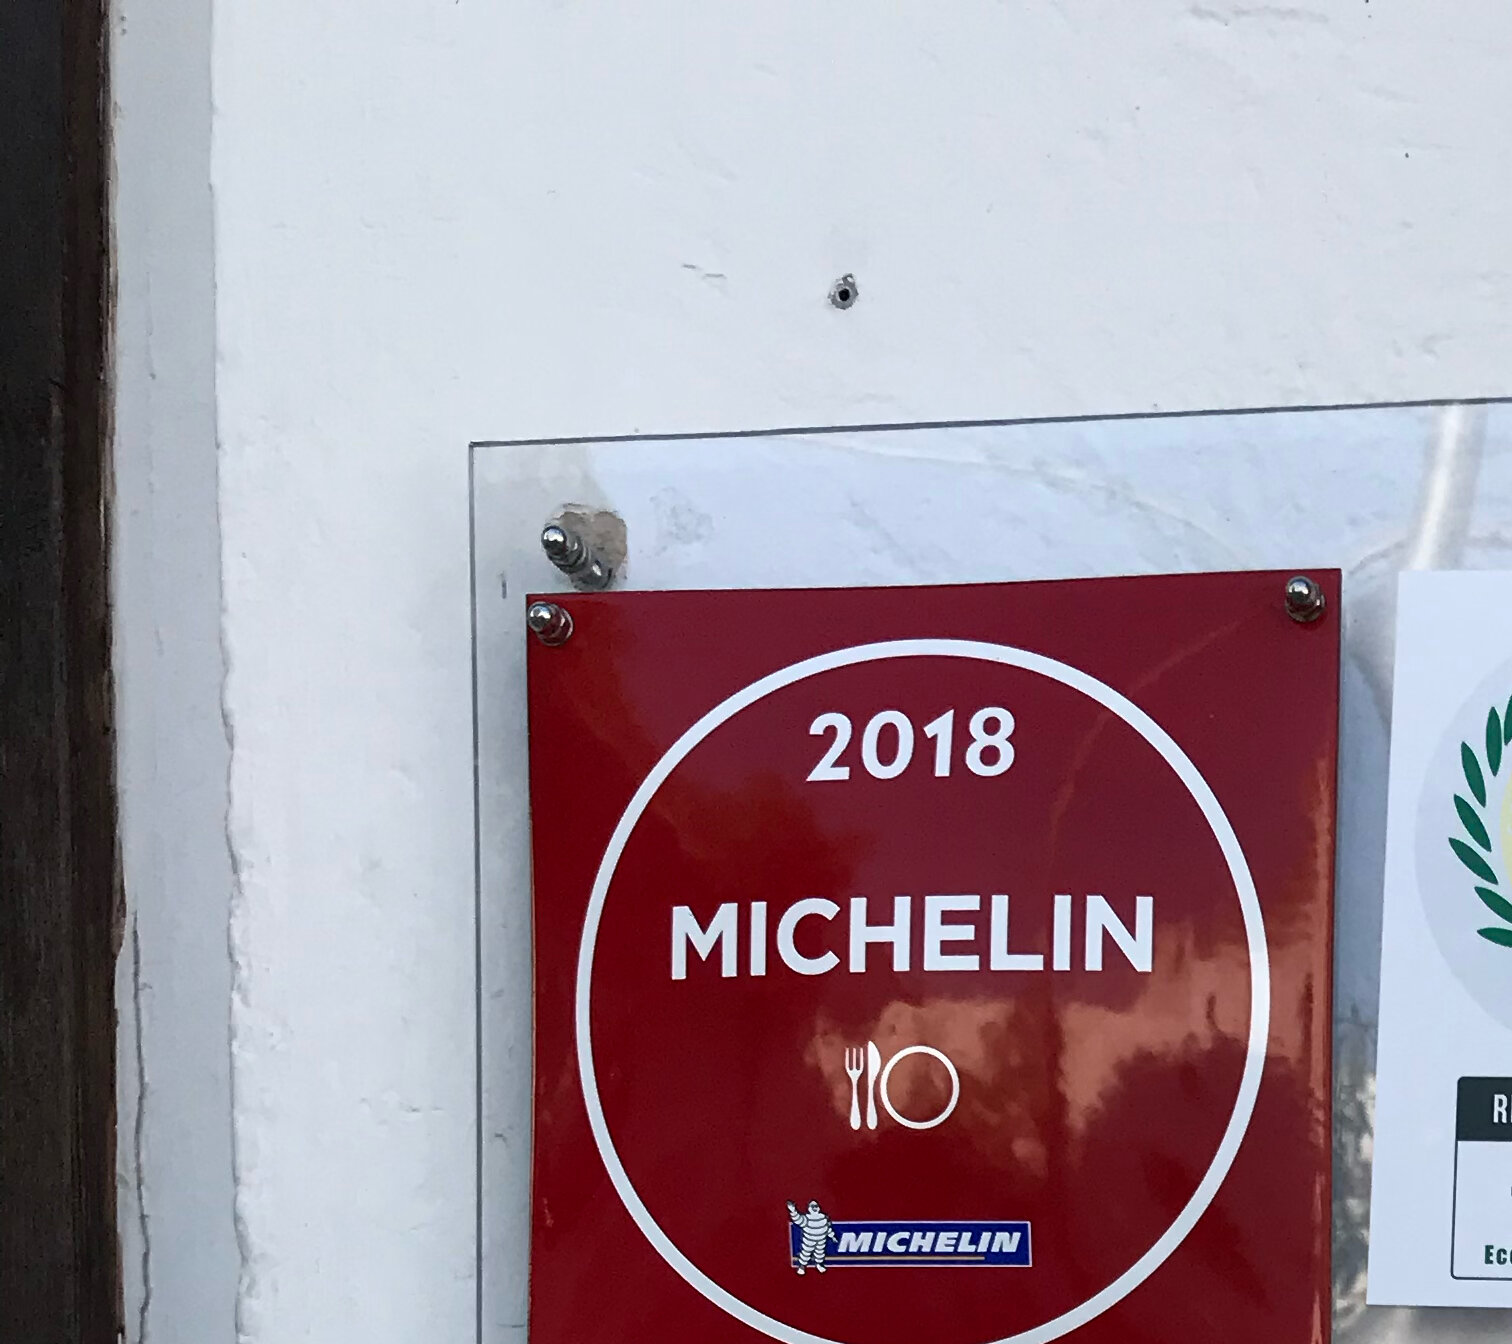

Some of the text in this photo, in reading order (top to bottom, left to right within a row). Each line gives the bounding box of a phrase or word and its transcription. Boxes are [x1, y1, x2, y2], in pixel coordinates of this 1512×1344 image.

[807, 706, 1017, 782] 2018
[669, 893, 1156, 981] MICHELIN
[836, 1228, 1022, 1255] MICHELIN
